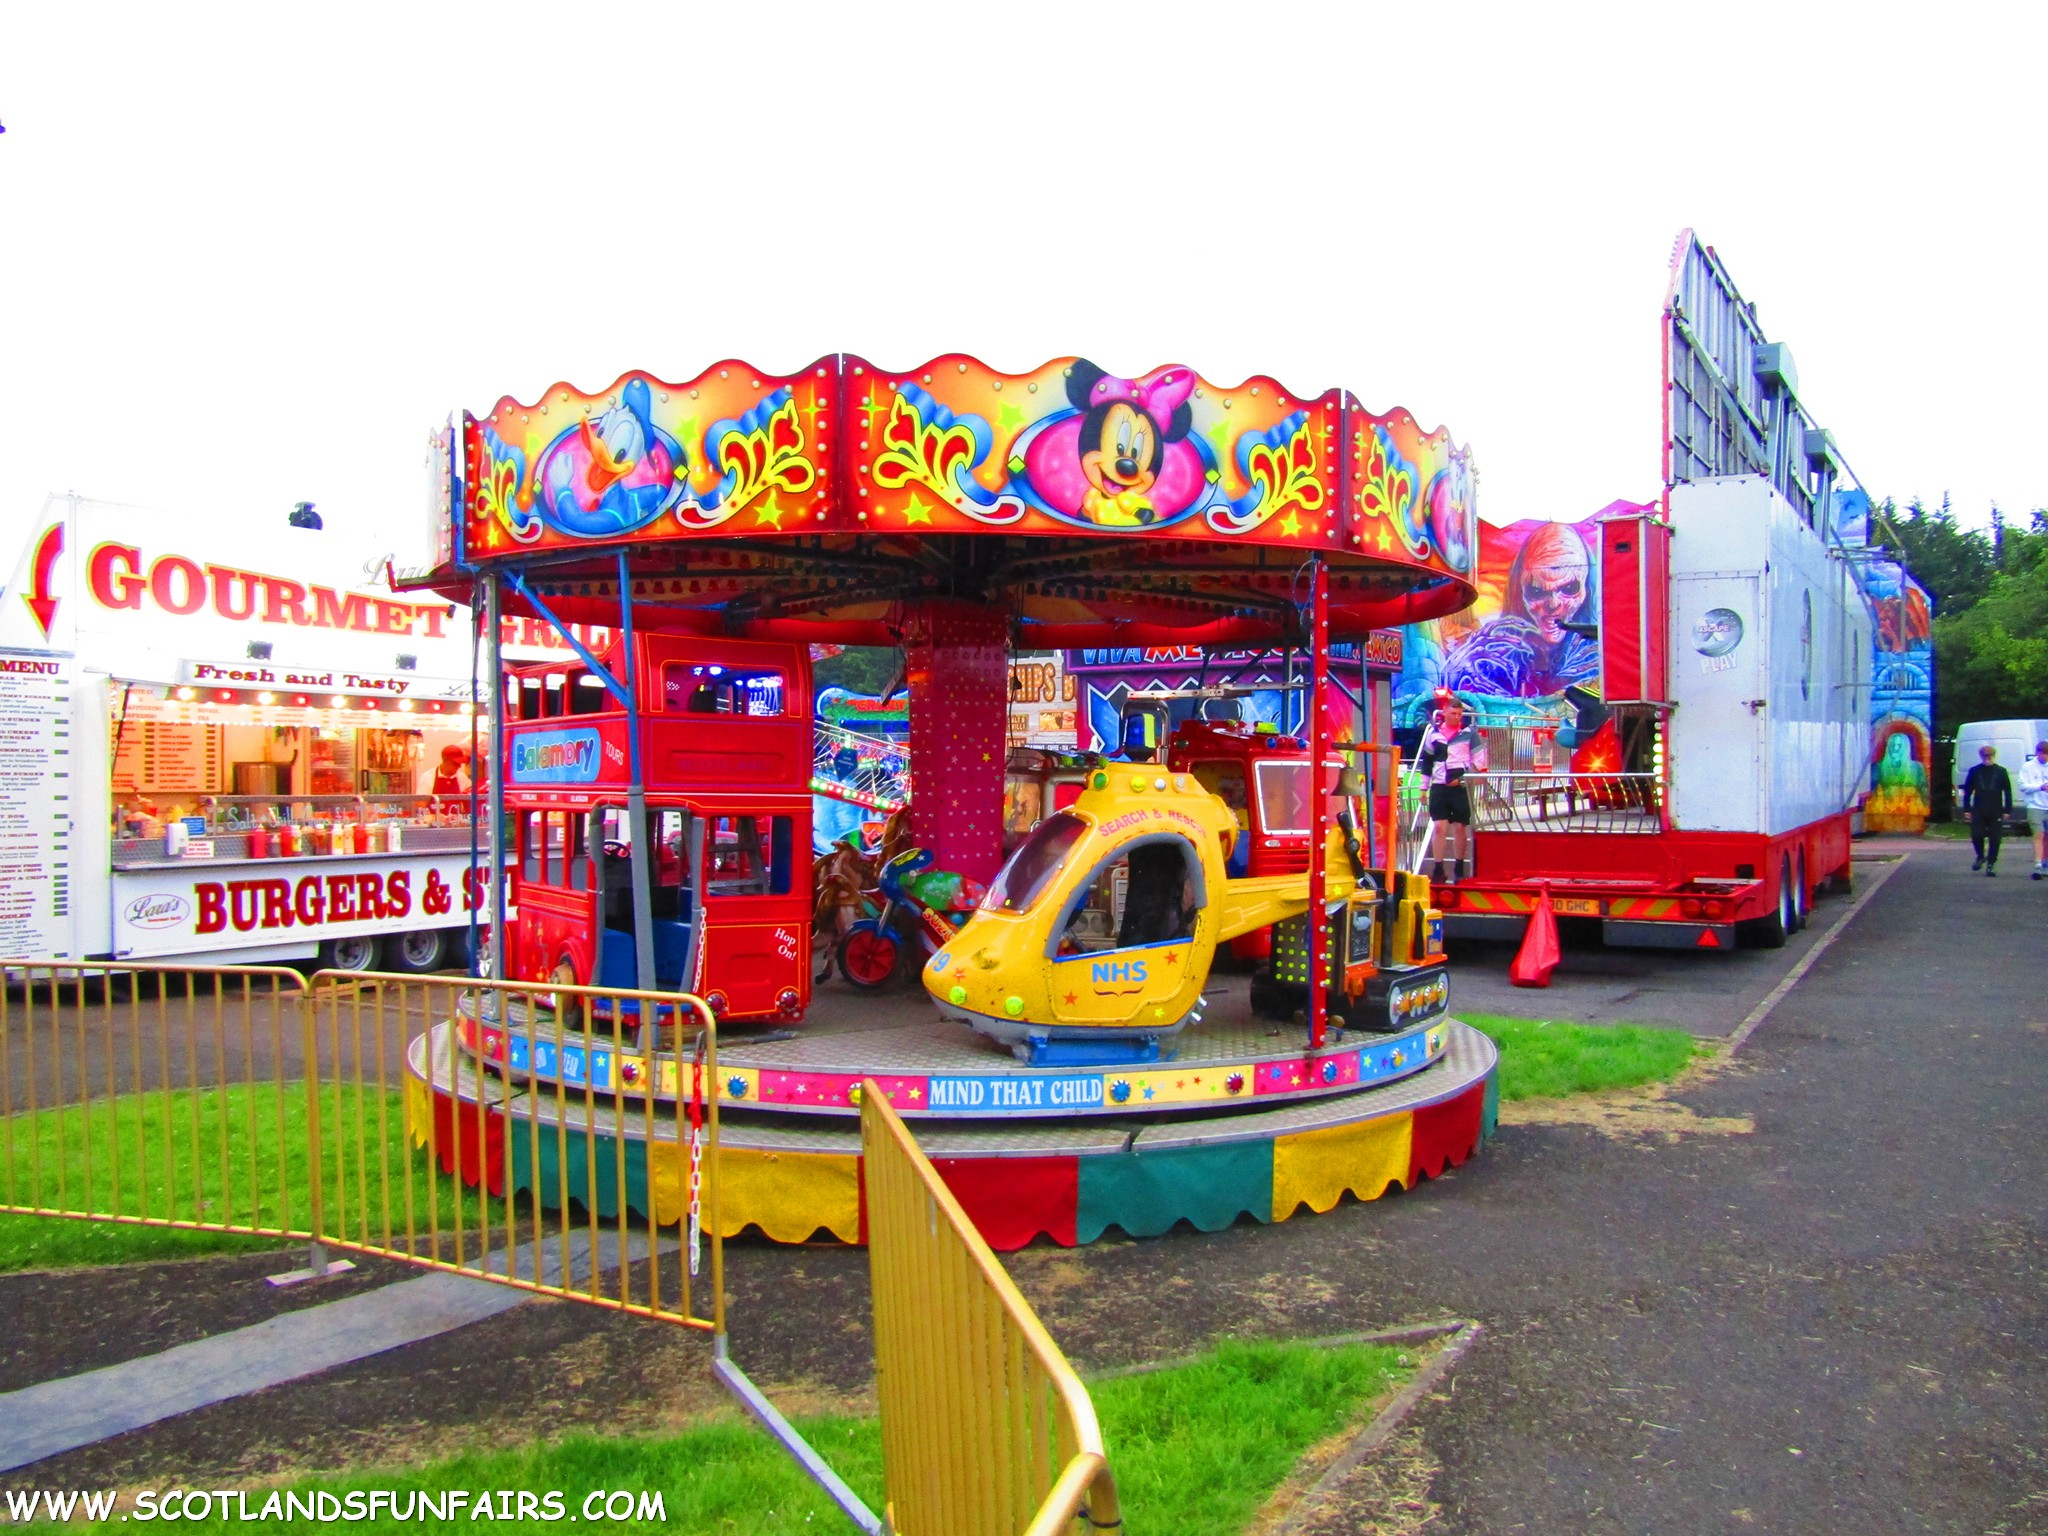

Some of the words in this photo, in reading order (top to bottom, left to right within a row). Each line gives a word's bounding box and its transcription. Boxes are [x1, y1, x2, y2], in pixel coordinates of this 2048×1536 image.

[86, 540, 454, 640] GOURMET
[0, 660, 60, 675] MENU
[1701, 653, 1737, 674] PLAY
[194, 664, 276, 683] Fresh
[285, 672, 333, 686] and
[342, 674, 410, 694] Tasty
[516, 738, 594, 774] Balamory
[605, 741, 625, 766] TOURS
[1098, 809, 1148, 837] SEARCH
[1152, 808, 1162, 819] &
[194, 870, 411, 934] BURGERS
[423, 868, 451, 915] &
[774, 927, 797, 947] Hop
[777, 944, 797, 961] On!
[1092, 960, 1148, 983] NHS
[930, 1080, 985, 1105] MIND
[990, 1080, 1045, 1106] THAT
[1050, 1078, 1102, 1105] CHILD
